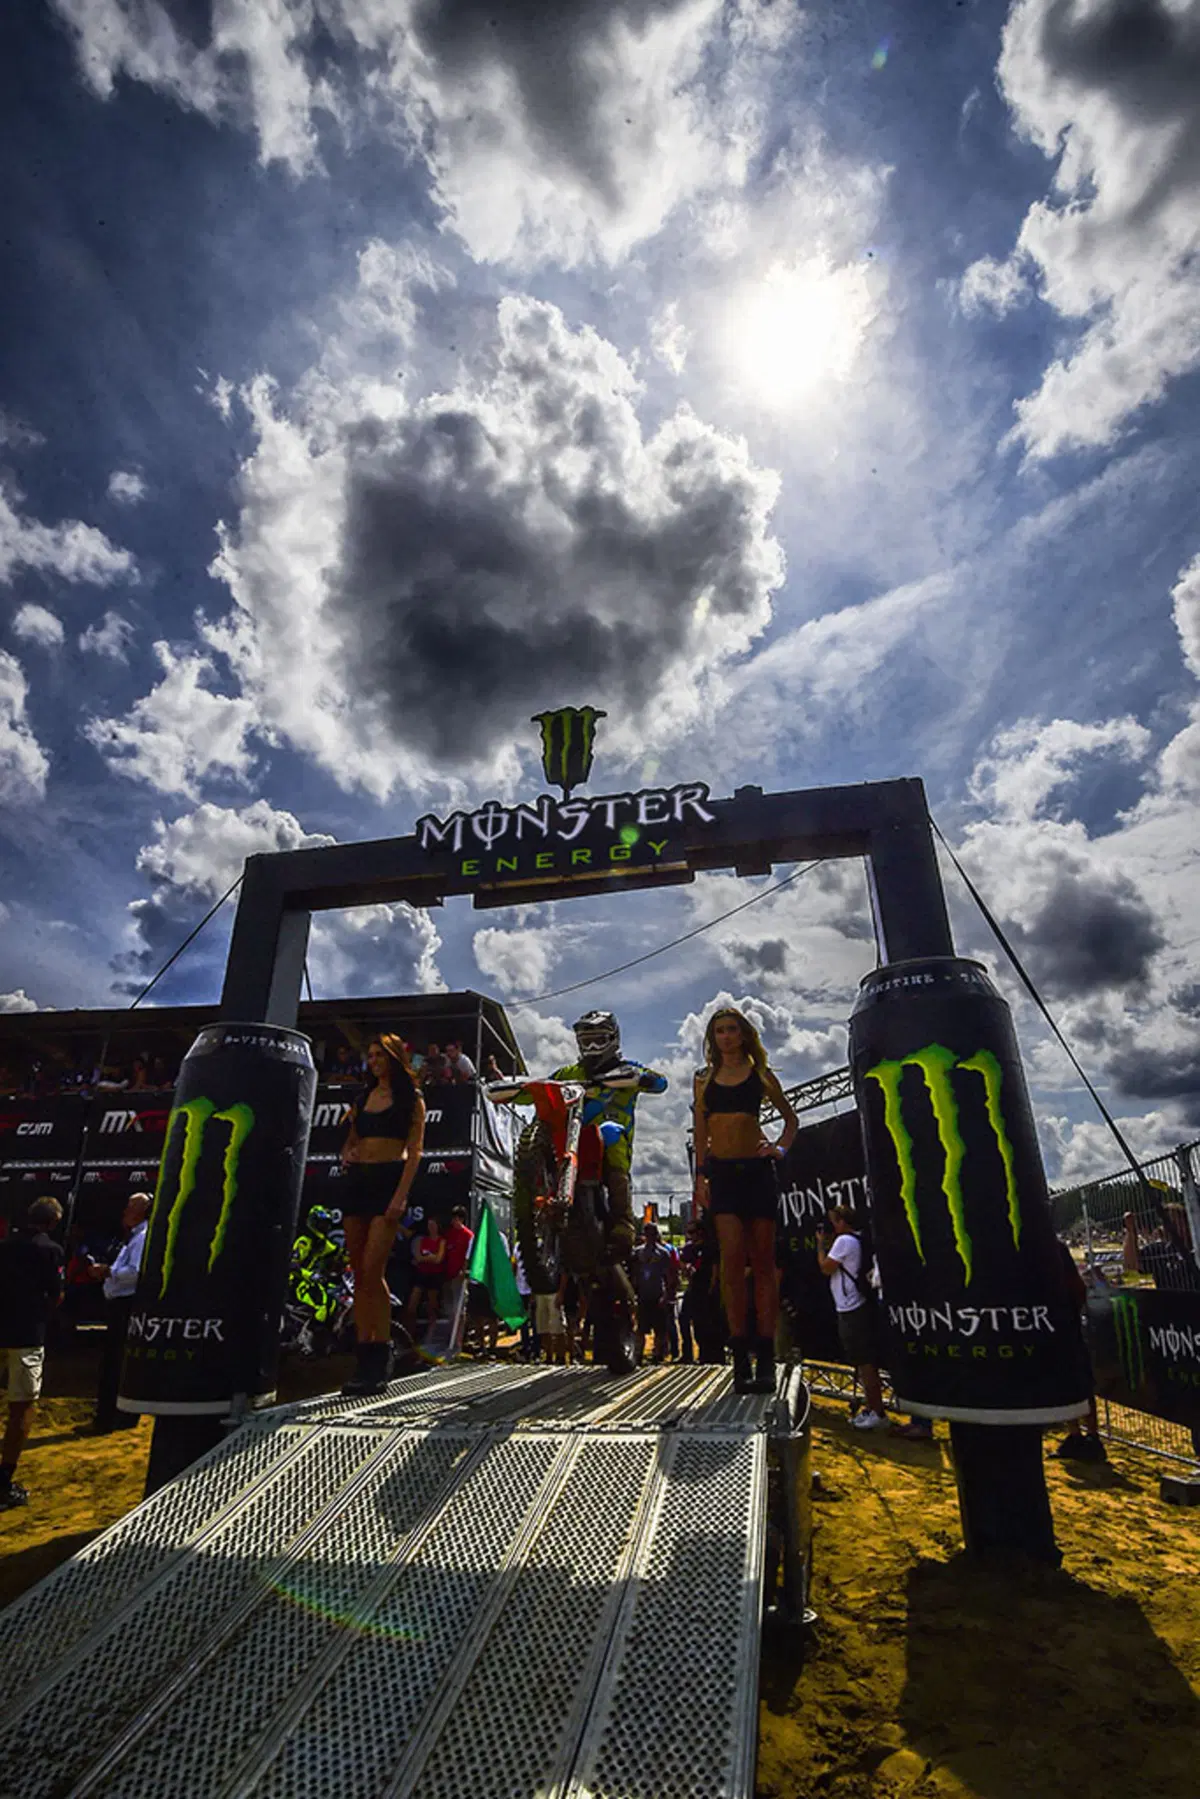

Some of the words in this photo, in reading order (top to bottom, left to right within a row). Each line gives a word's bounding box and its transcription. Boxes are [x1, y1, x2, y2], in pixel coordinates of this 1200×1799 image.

[420, 787, 716, 853] MONSTER
[460, 839, 669, 877] ENERGY
[888, 1300, 1056, 1337] MONSTER
[906, 1341, 1034, 1359] ENERGY
